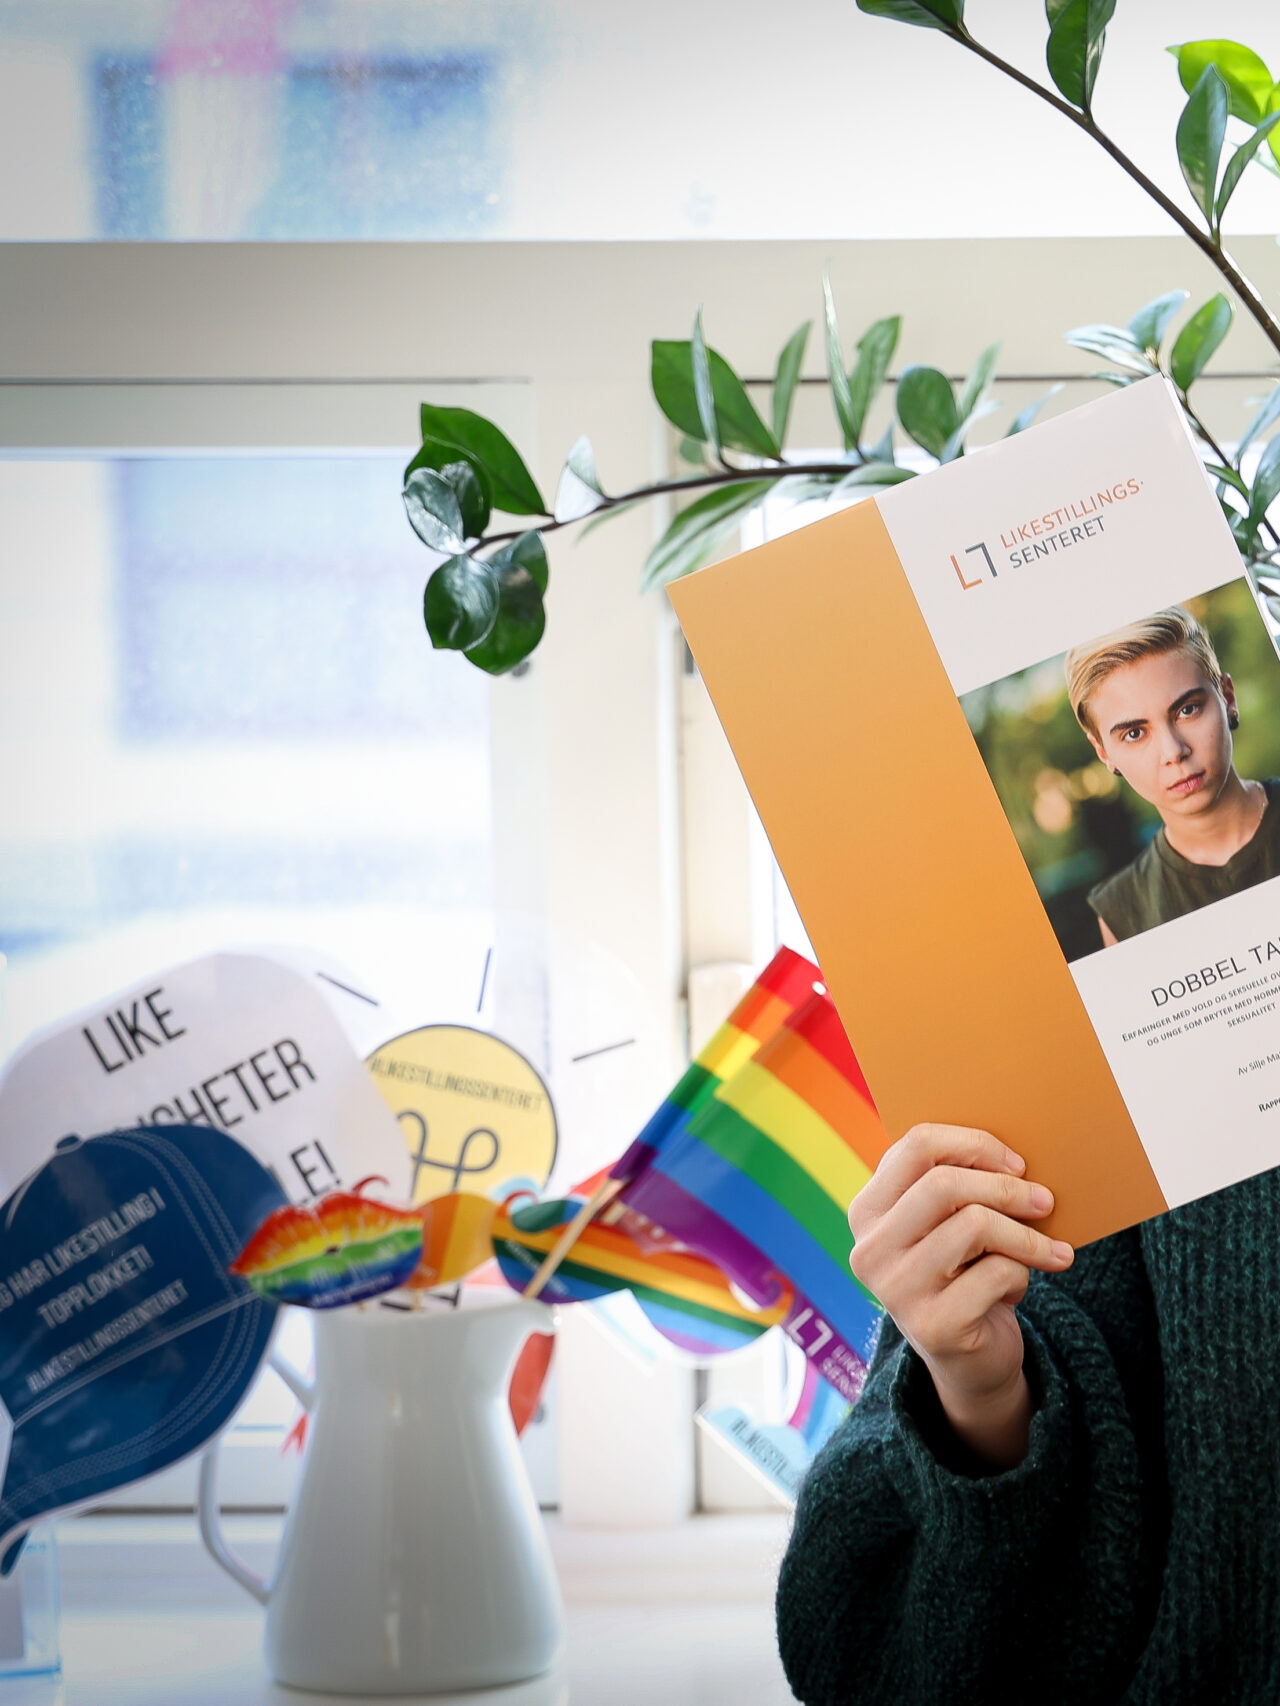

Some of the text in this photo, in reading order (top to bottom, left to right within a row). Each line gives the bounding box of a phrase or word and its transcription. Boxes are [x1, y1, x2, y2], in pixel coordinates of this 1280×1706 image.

[1009, 515, 1106, 569] SENTERET
[1121, 1017, 1172, 1042] ERFARINGER
[1172, 1008, 1191, 1022] MED
[1192, 1000, 1213, 1013] VOLD
[1214, 994, 1227, 1004] OG
[1228, 976, 1268, 999] SEKSUELLE
[1151, 957, 1247, 1007] DOBBEL
[83, 987, 187, 1074] LIKE
[1146, 1036, 1160, 1047] OG
[1160, 1027, 1182, 1041] UNGE
[1183, 1018, 1203, 1031] SOM
[1203, 1006, 1233, 1024] BRYTER
[1235, 998, 1253, 1011] MED
[1227, 1002, 1277, 1029] SEKSUALITET
[1238, 1066, 1248, 1076] Av
[1248, 1059, 1266, 1071] Silje
[7, 1259, 52, 1299] HAR
[44, 1192, 157, 1276] LIKESTILLING
[37, 1244, 155, 1328] TOPPLOKKET!
